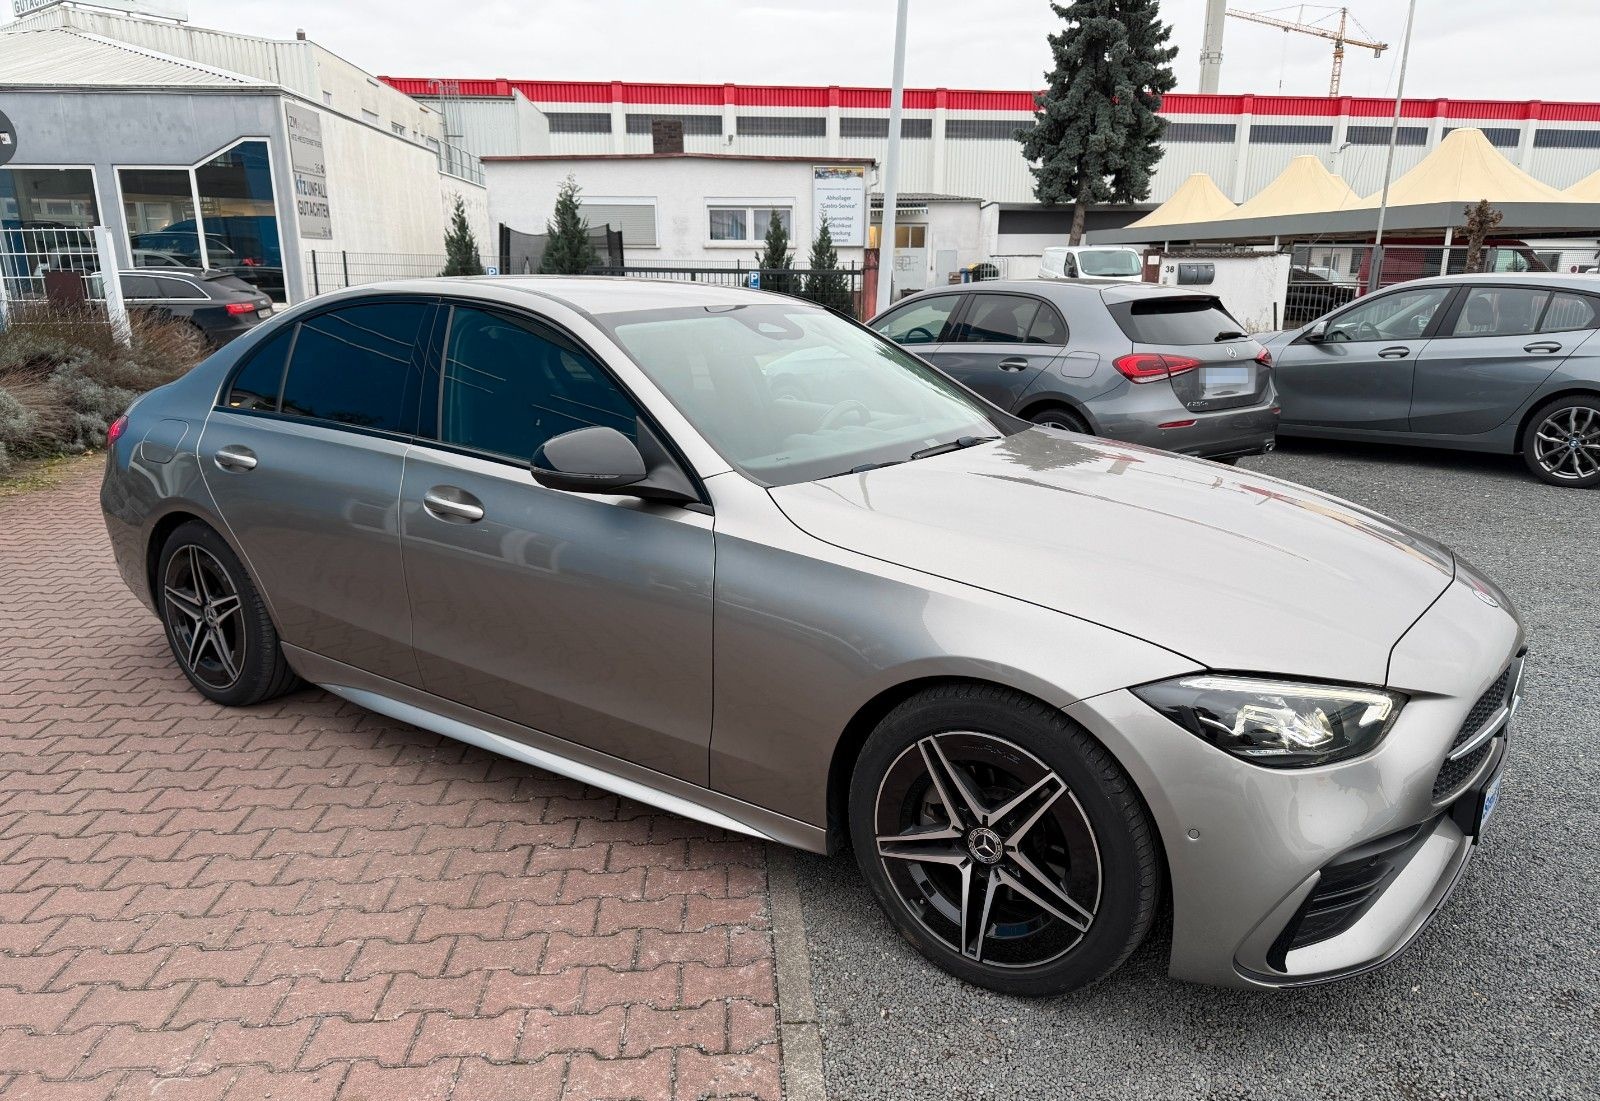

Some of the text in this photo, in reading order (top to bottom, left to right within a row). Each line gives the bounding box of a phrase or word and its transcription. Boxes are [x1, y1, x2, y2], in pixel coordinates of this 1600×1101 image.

[298, 199, 330, 217] GUTACHTEN
[1165, 265, 1175, 273] 38
[750, 273, 758, 283] P
